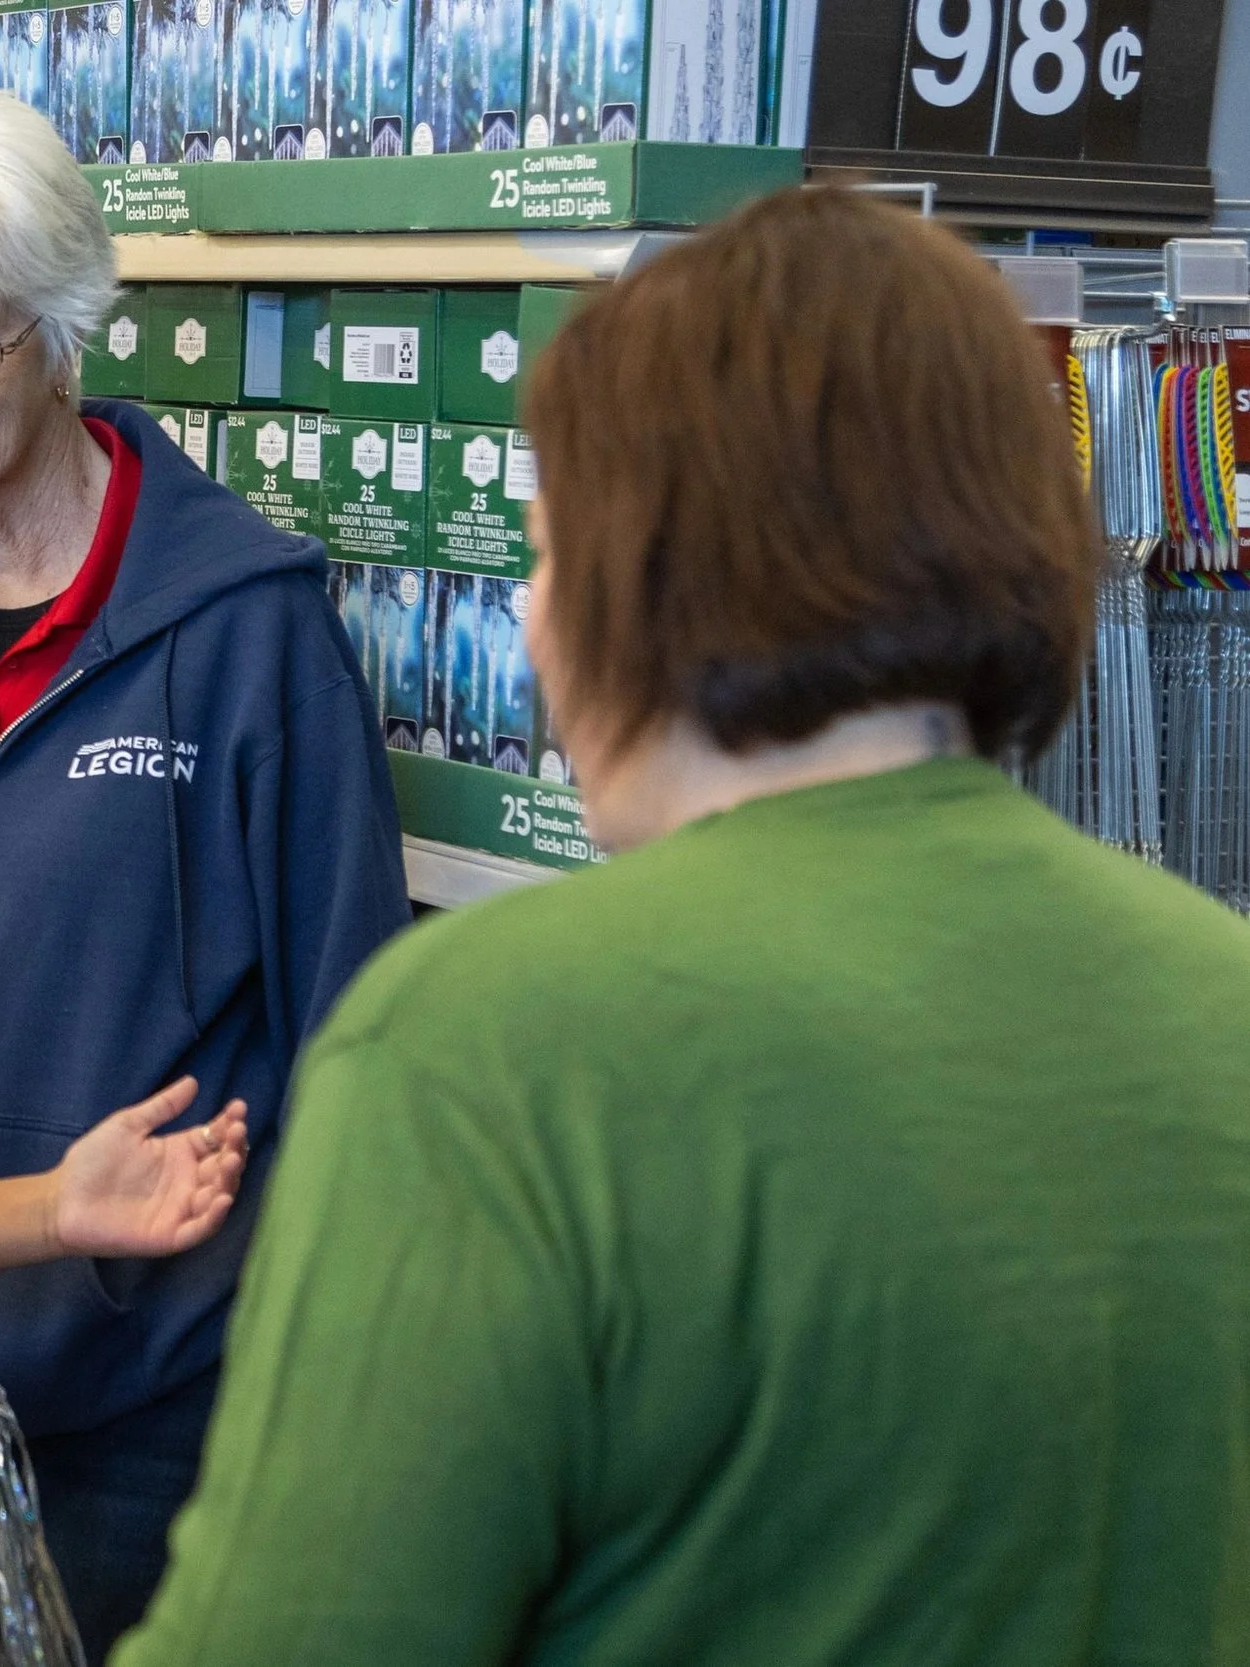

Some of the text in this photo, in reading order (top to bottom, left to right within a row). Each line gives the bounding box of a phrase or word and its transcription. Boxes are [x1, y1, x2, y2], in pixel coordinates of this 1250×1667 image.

[522, 154, 597, 173] Cool White/Blue
[125, 167, 179, 183] Cool White/Blue
[102, 179, 124, 212] 25
[125, 187, 186, 203] Random Twinkling
[489, 169, 520, 208] 25
[522, 177, 606, 196] Random Twinkling
[126, 203, 189, 223] Icicle LED Lights
[522, 196, 611, 220] Icicle LED Lights
[190, 413, 203, 424] LED
[300, 419, 316, 430] LED
[399, 428, 417, 440] LED
[263, 474, 277, 491] 25
[246, 491, 293, 505] COOL WHITE
[360, 484, 376, 503] 25
[471, 493, 488, 511] 25
[265, 507, 309, 519] TWINKLING
[343, 503, 393, 517] COOL WHITE
[452, 511, 506, 526] COOL WHITE
[328, 514, 409, 531] RANDOM TWINKLING
[339, 527, 396, 542] ICICLE LIGHTS
[437, 522, 523, 542] RANDOM TWINKLING
[448, 536, 508, 553] ICICLE LIGHTS
[107, 736, 199, 757] AMERIAN
[67, 750, 196, 784] LEGION
[534, 790, 556, 809] Cool
[500, 794, 531, 837] 25
[533, 812, 573, 835] Random
[533, 832, 563, 855] Icicle
[564, 839, 588, 860] LED
